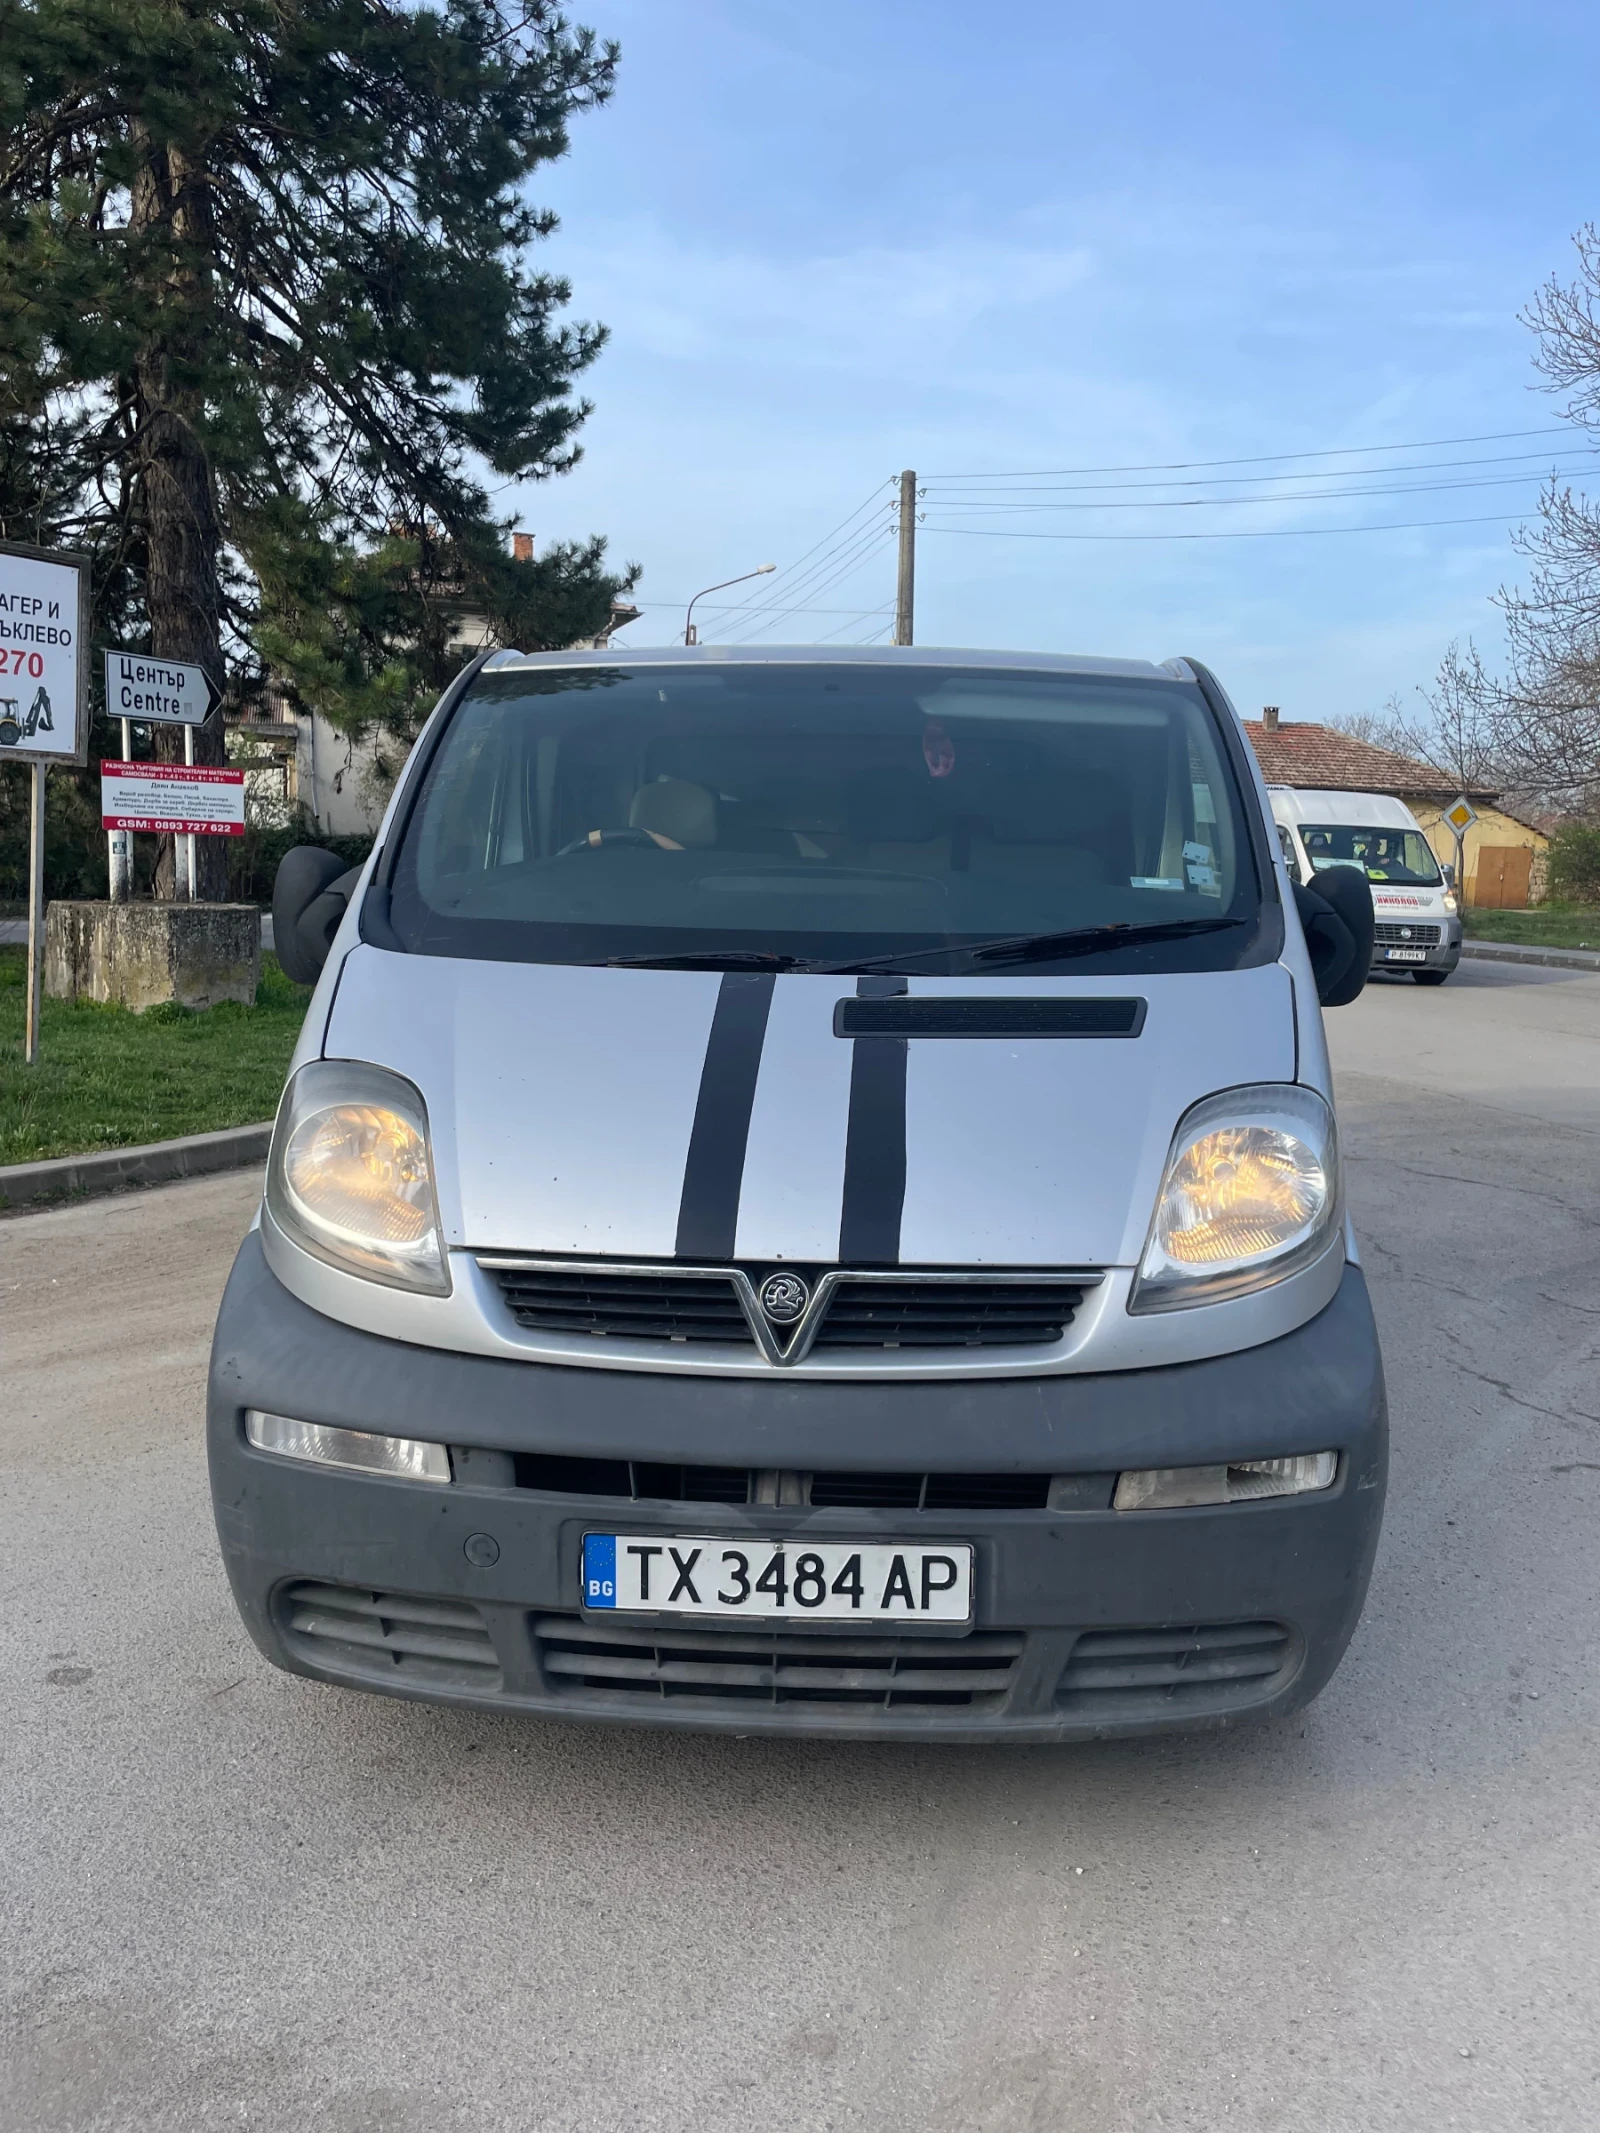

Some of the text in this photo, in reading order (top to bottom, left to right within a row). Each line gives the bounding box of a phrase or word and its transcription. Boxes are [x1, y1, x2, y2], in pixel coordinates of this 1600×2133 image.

[48, 601, 59, 619] И
[120, 657, 185, 692] Център
[121, 686, 180, 715] Centre
[121, 770, 155, 778] САМОСВАЛИ
[173, 767, 207, 775] СТРОИТЕЛНИ
[117, 819, 231, 833] GSM: 0893 727 622
[588, 1545, 958, 1610] BG TX 3484 AP
